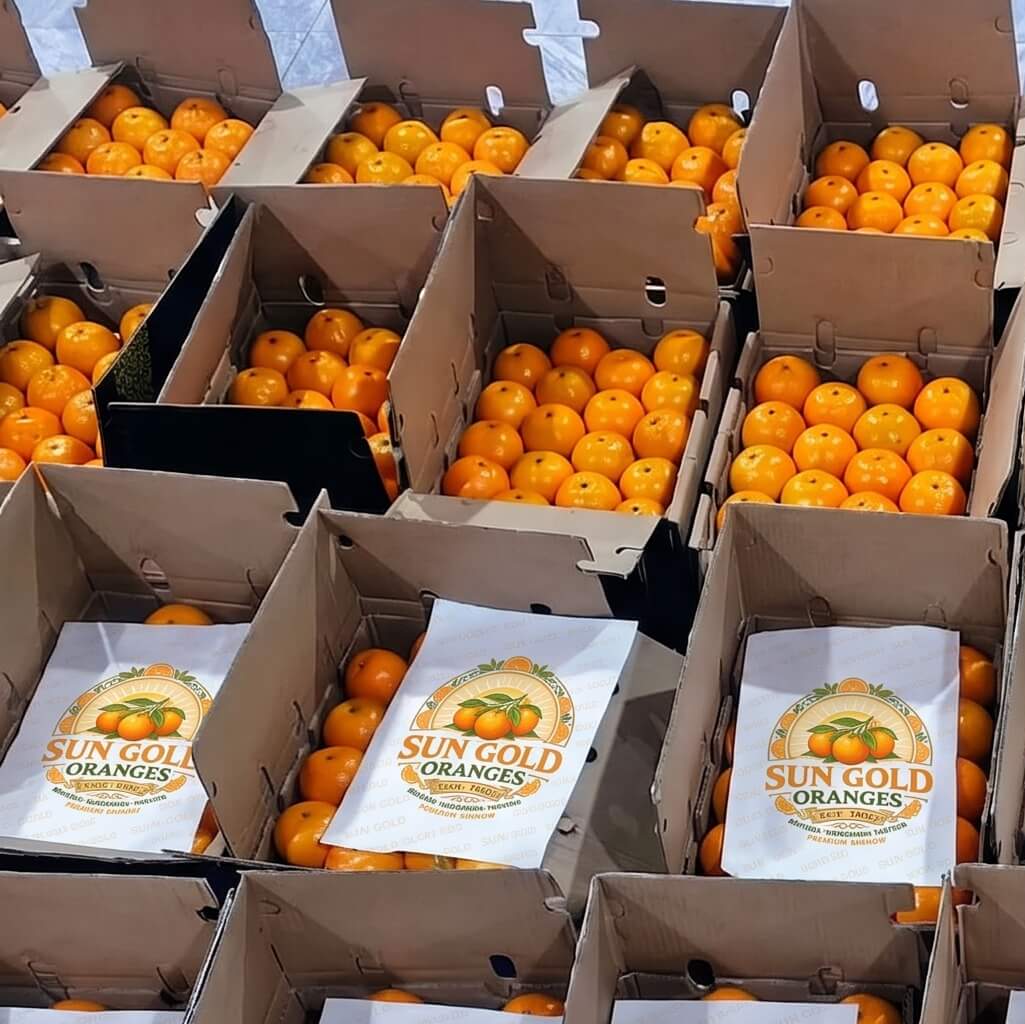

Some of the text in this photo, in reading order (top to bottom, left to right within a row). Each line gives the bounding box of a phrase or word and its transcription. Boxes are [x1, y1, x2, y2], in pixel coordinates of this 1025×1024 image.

[41, 738, 114, 762] SUN
[397, 735, 563, 774] SUN GOLD
[65, 762, 172, 782] ORANGES
[420, 761, 527, 786] ORANGES
[765, 764, 934, 793] SUN GOLD
[792, 790, 903, 808] ORANGES
